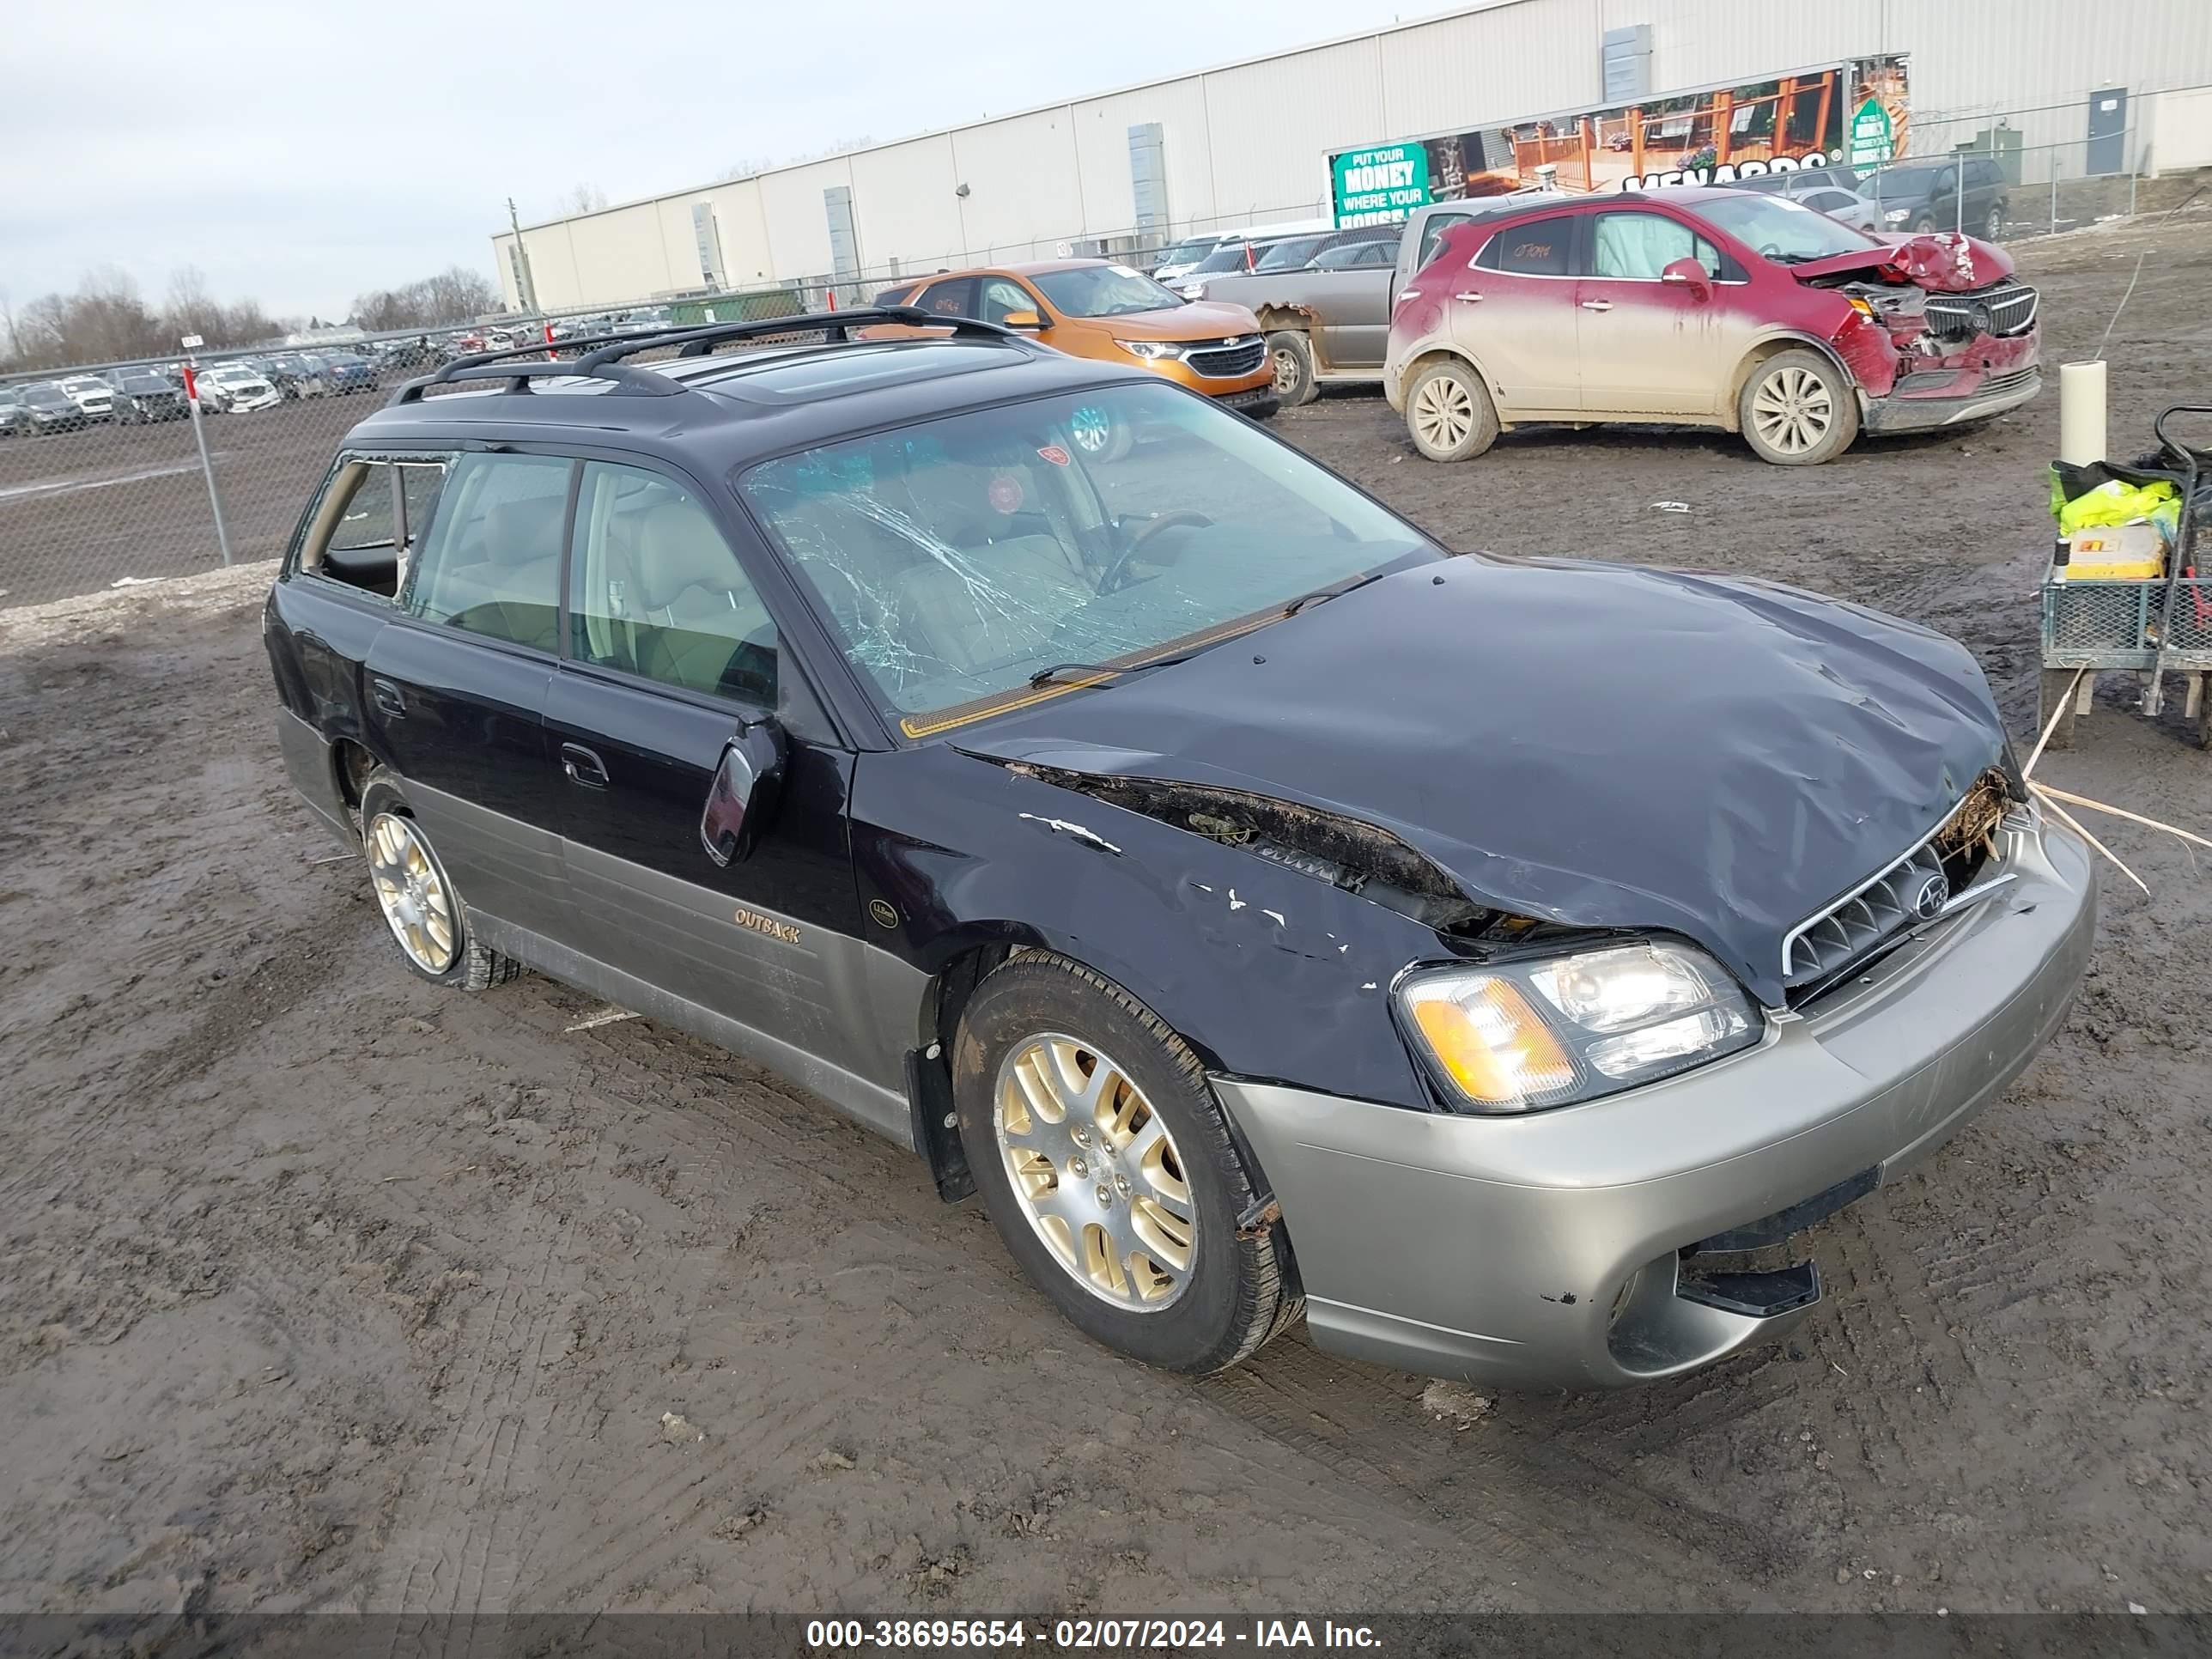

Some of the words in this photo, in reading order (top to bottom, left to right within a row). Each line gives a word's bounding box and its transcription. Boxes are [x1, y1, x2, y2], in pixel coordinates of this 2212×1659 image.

[1352, 153, 1374, 166] PUT
[1374, 149, 1404, 163] YOUR
[1345, 161, 1415, 194] MONEY
[1344, 193, 1388, 211] WHERE
[1389, 188, 1422, 205] YOUR
[735, 908, 801, 944] OUTBACK
